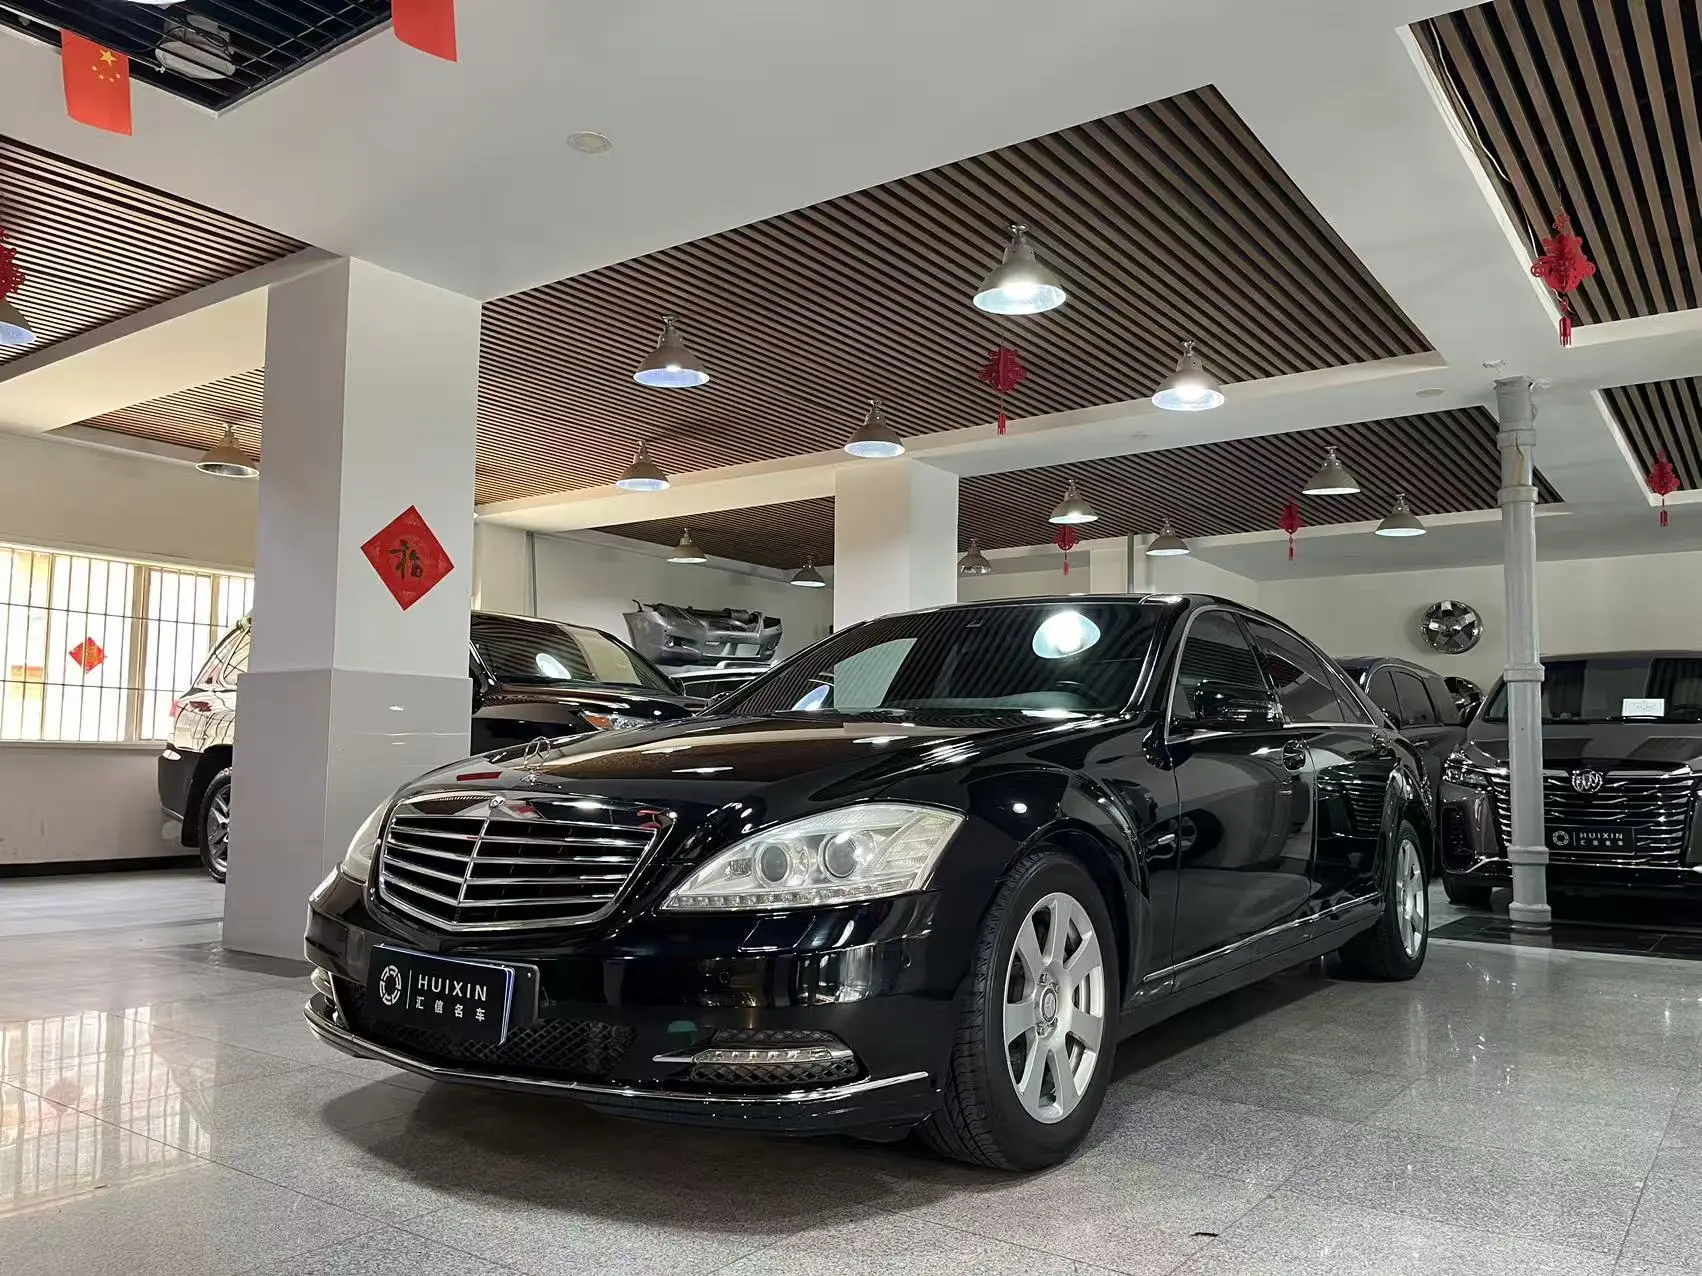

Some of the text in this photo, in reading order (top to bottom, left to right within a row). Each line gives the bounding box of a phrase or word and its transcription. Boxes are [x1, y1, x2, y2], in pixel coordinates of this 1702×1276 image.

[388, 539, 423, 580] 福
[418, 974, 487, 1001] HUIXIN
[415, 996, 486, 1022] 汇信名车
